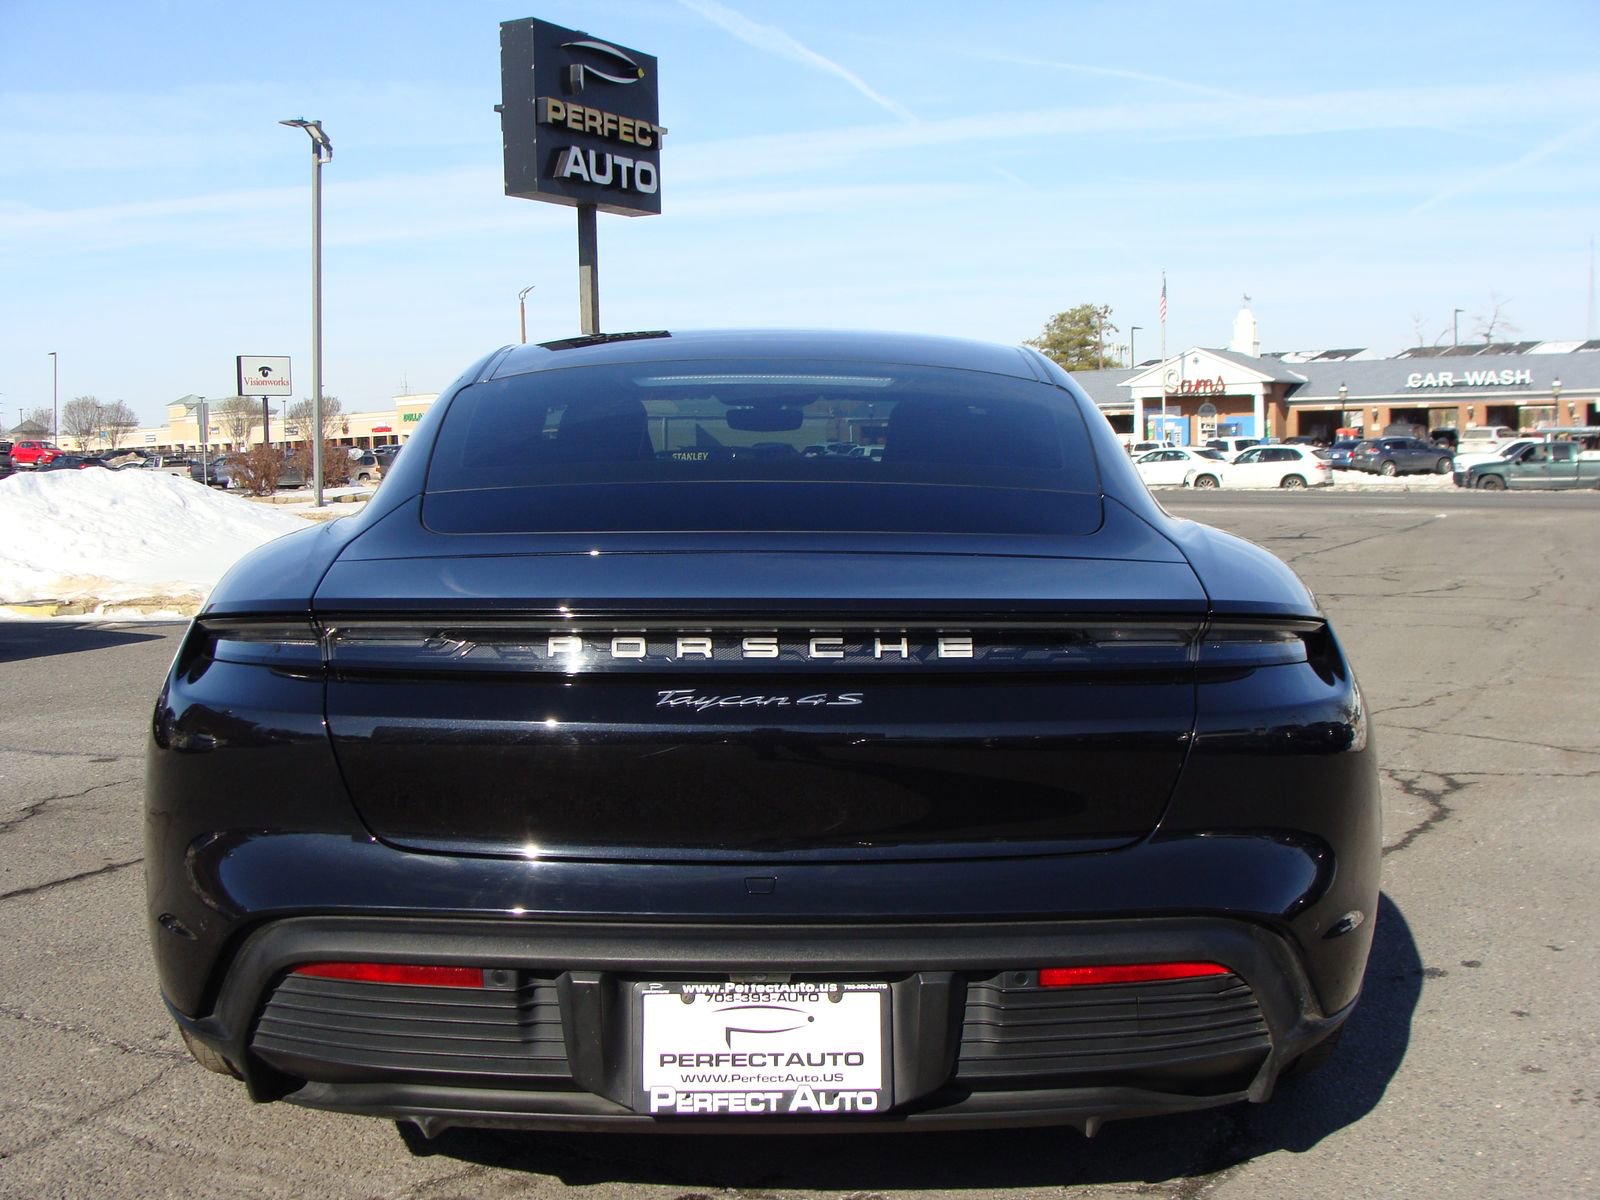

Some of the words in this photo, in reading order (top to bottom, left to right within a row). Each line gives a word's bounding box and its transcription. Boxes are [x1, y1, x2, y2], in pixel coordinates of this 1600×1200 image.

[547, 97, 668, 150] PERFECT
[563, 146, 658, 194] AUTO
[244, 377, 289, 386] Visionworks
[1406, 373, 1454, 388] CAR
[1464, 369, 1532, 386] WASH
[672, 452, 708, 460] STANLEY
[548, 637, 974, 658] PORSCHE
[656, 689, 791, 712] Taycan
[682, 982, 838, 993] www.PerfectAuto.us
[706, 992, 820, 1002] 703-393-AUTO
[659, 1052, 864, 1067] PERFECTAUTO
[680, 1073, 844, 1083] WWW.PerfectAuto.US
[650, 1085, 783, 1112] PERFECT
[789, 1084, 878, 1112] AUTO
